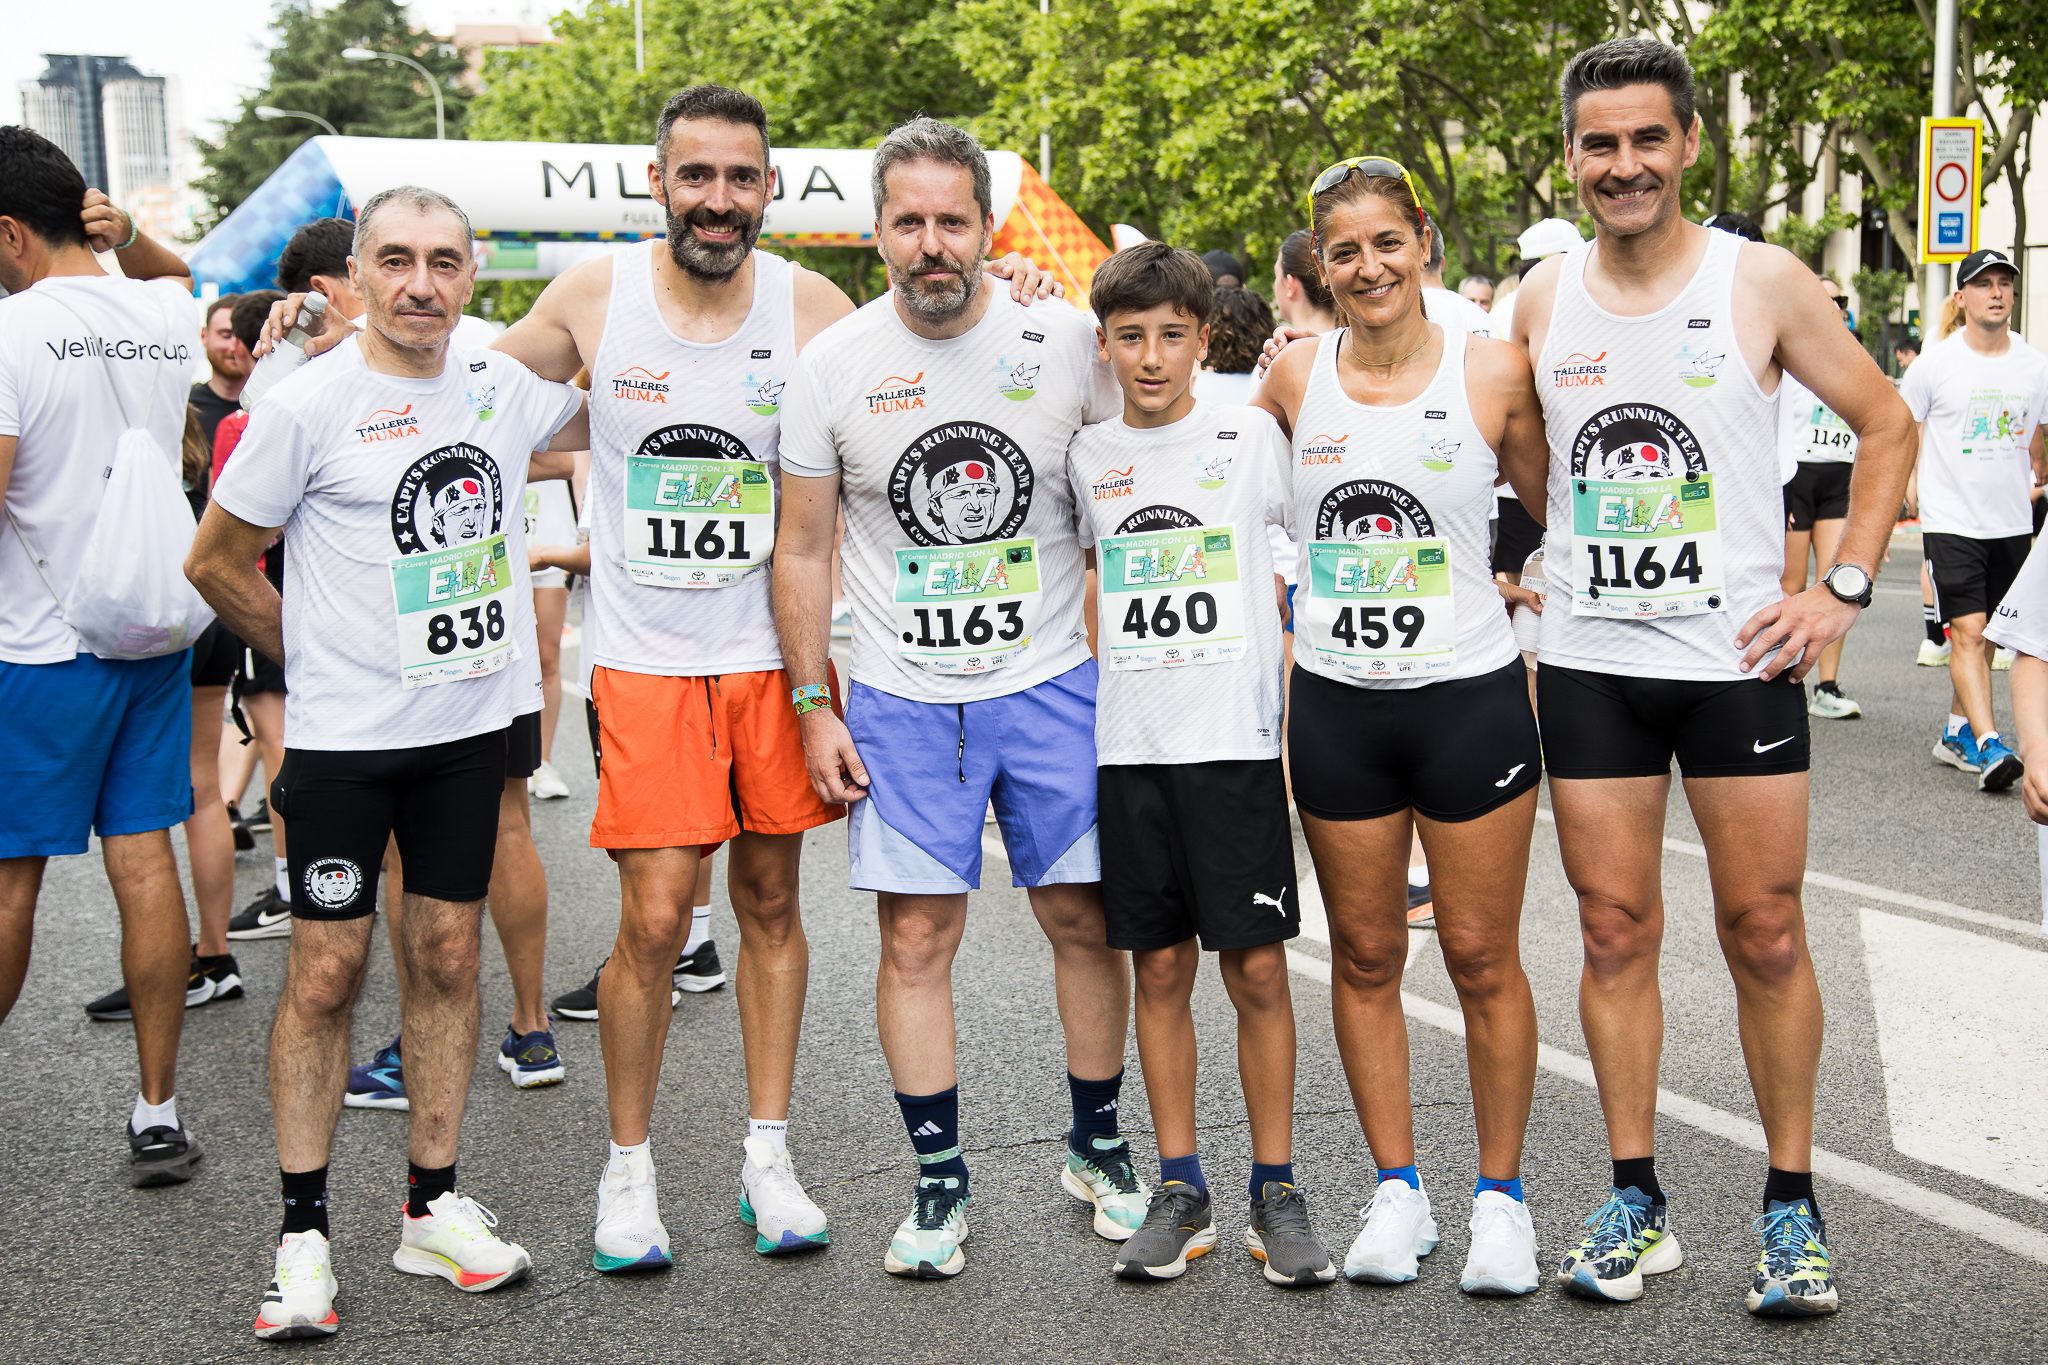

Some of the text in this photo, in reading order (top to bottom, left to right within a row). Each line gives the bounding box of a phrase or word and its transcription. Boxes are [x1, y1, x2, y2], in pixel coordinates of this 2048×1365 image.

[541, 160, 845, 201] MUA
[1553, 365, 1607, 381] TALLERES
[1555, 374, 1606, 388] JUMA
[612, 379, 669, 393] TALLERES
[615, 387, 667, 404] JUMA
[866, 386, 926, 408] TALLERES
[870, 396, 925, 415] JUMA
[356, 416, 418, 438] TALLERES
[1597, 407, 1677, 433] RUNNING
[362, 425, 422, 444] JUMA
[658, 428, 740, 453] RUNNING
[1812, 428, 1851, 448] 1149
[1301, 446, 1346, 460] TALLERES
[1302, 453, 1343, 466] JUMA
[661, 463, 698, 472] MADRID
[701, 464, 720, 472] CON
[722, 465, 735, 473] LA
[893, 426, 1031, 503] CAPI'S RUNNING TEAM
[397, 446, 501, 524] CAPI'S RUNNING TEAM
[654, 471, 742, 508] ELA
[1093, 477, 1134, 495] TALLERES
[1094, 485, 1133, 500] JUMA
[1600, 485, 1634, 494] MADRID
[1635, 486, 1658, 494] CON
[1658, 484, 1672, 493] LA
[1126, 508, 1192, 530] RUNNING
[1318, 483, 1434, 540] API'S RUNNING TEA
[1596, 493, 1684, 533] ELA
[647, 518, 751, 560] 1161
[1126, 538, 1159, 548] MADRID
[1161, 537, 1182, 545] CON
[1184, 535, 1196, 543] LA
[429, 552, 462, 565] MADRID
[464, 547, 480, 557] CON
[929, 552, 964, 561] MADRID
[966, 550, 985, 558] CON
[1338, 548, 1370, 556] MADRID
[1122, 543, 1207, 586] ELA
[1333, 555, 1419, 594] ELA
[1587, 541, 1703, 590] 1164
[427, 553, 497, 603] ELA
[922, 556, 1009, 596] ELA
[1122, 591, 1218, 639] 460
[1996, 605, 2018, 619] UA
[427, 599, 505, 655] 838
[913, 600, 1024, 648] 1163
[1331, 605, 1425, 649] 459
[407, 671, 433, 679] MUKUA
[316, 858, 353, 867] RUNNING
[351, 864, 362, 882] TEAM
[757, 1124, 786, 1132] KIPRUN
